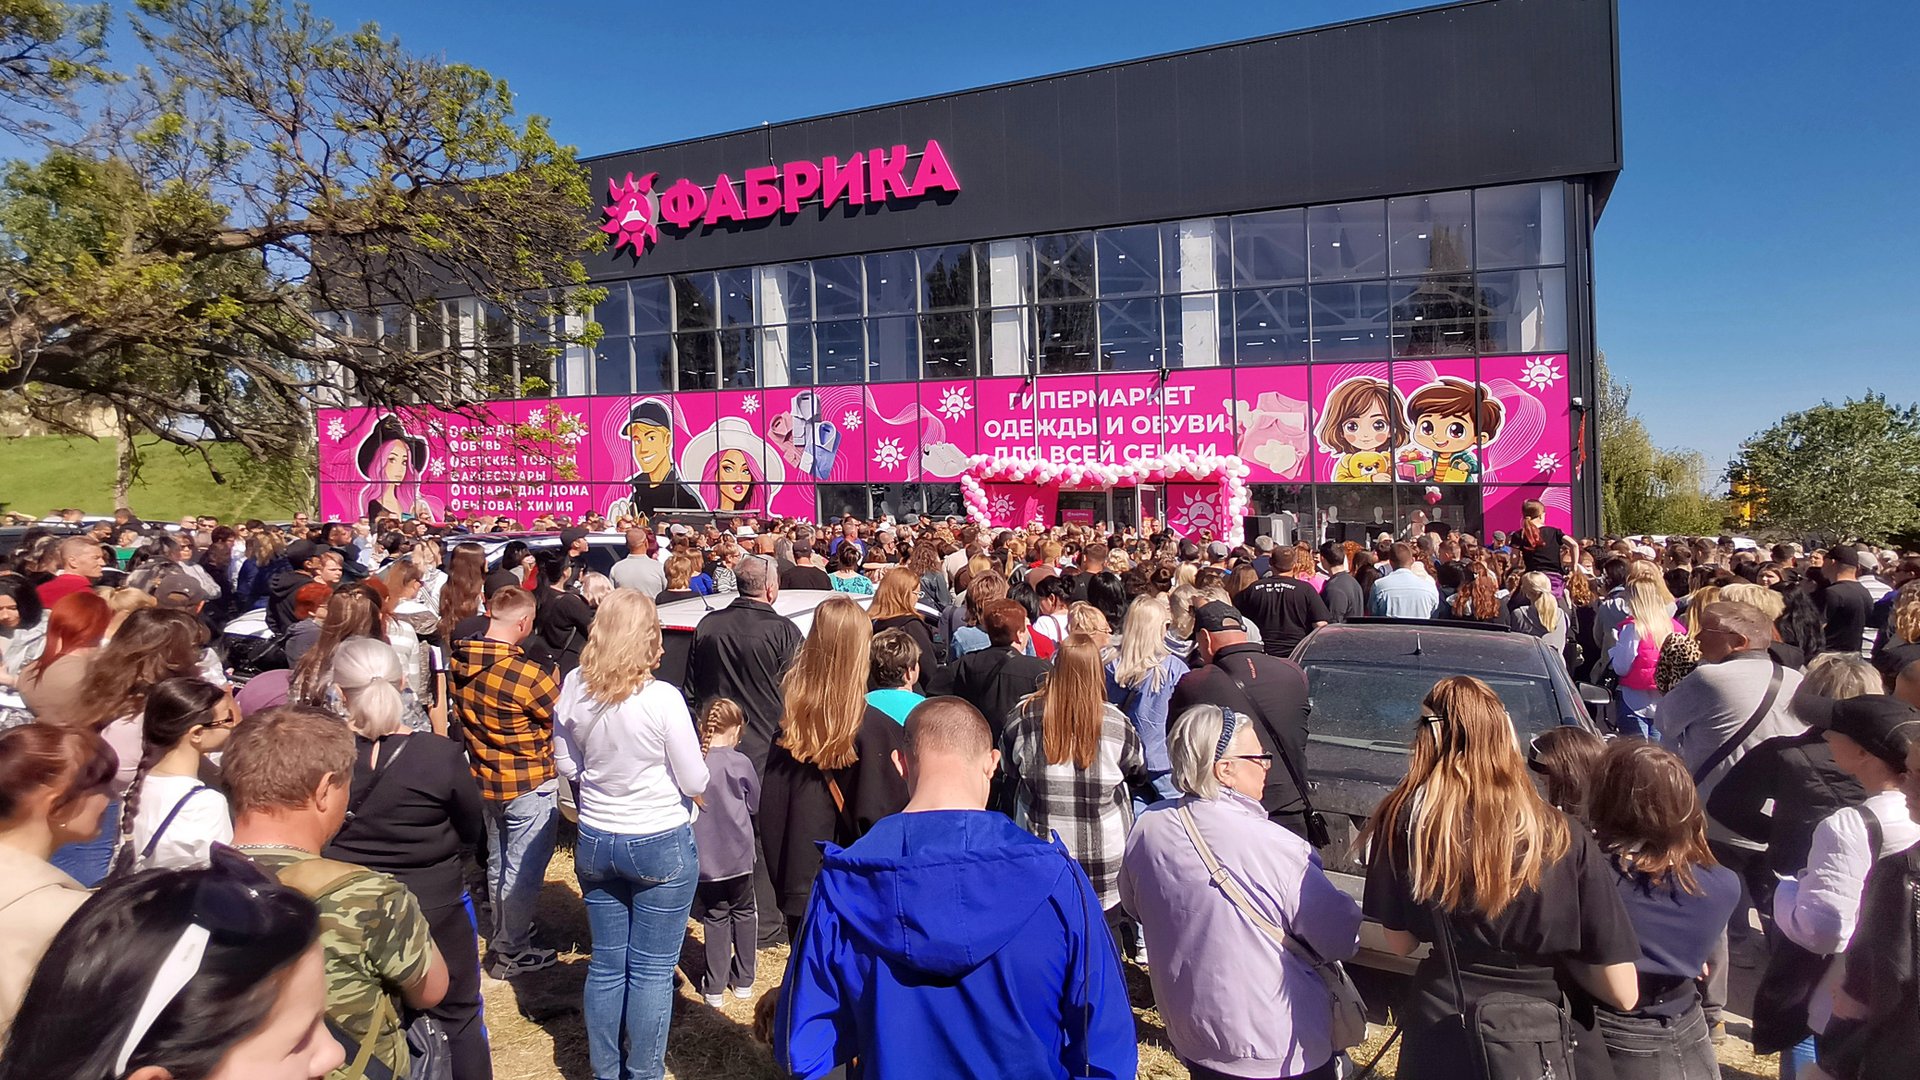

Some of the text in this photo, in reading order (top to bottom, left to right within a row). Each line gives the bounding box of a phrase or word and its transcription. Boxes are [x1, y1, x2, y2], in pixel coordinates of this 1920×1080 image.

[660, 139, 961, 228] ФАБРИКА
[1008, 385, 1196, 410] ГИПЕРМАРКЕТ
[984, 413, 1225, 440] ОДЕЖДЫ И ОБУВИ
[994, 445, 1043, 463] ДЛЯ
[1050, 440, 1116, 463] ВСЕЙ
[517, 485, 545, 497] ДЛЯ
[549, 485, 589, 497] ДОМА
[527, 500, 574, 512] ХИМИЯ
